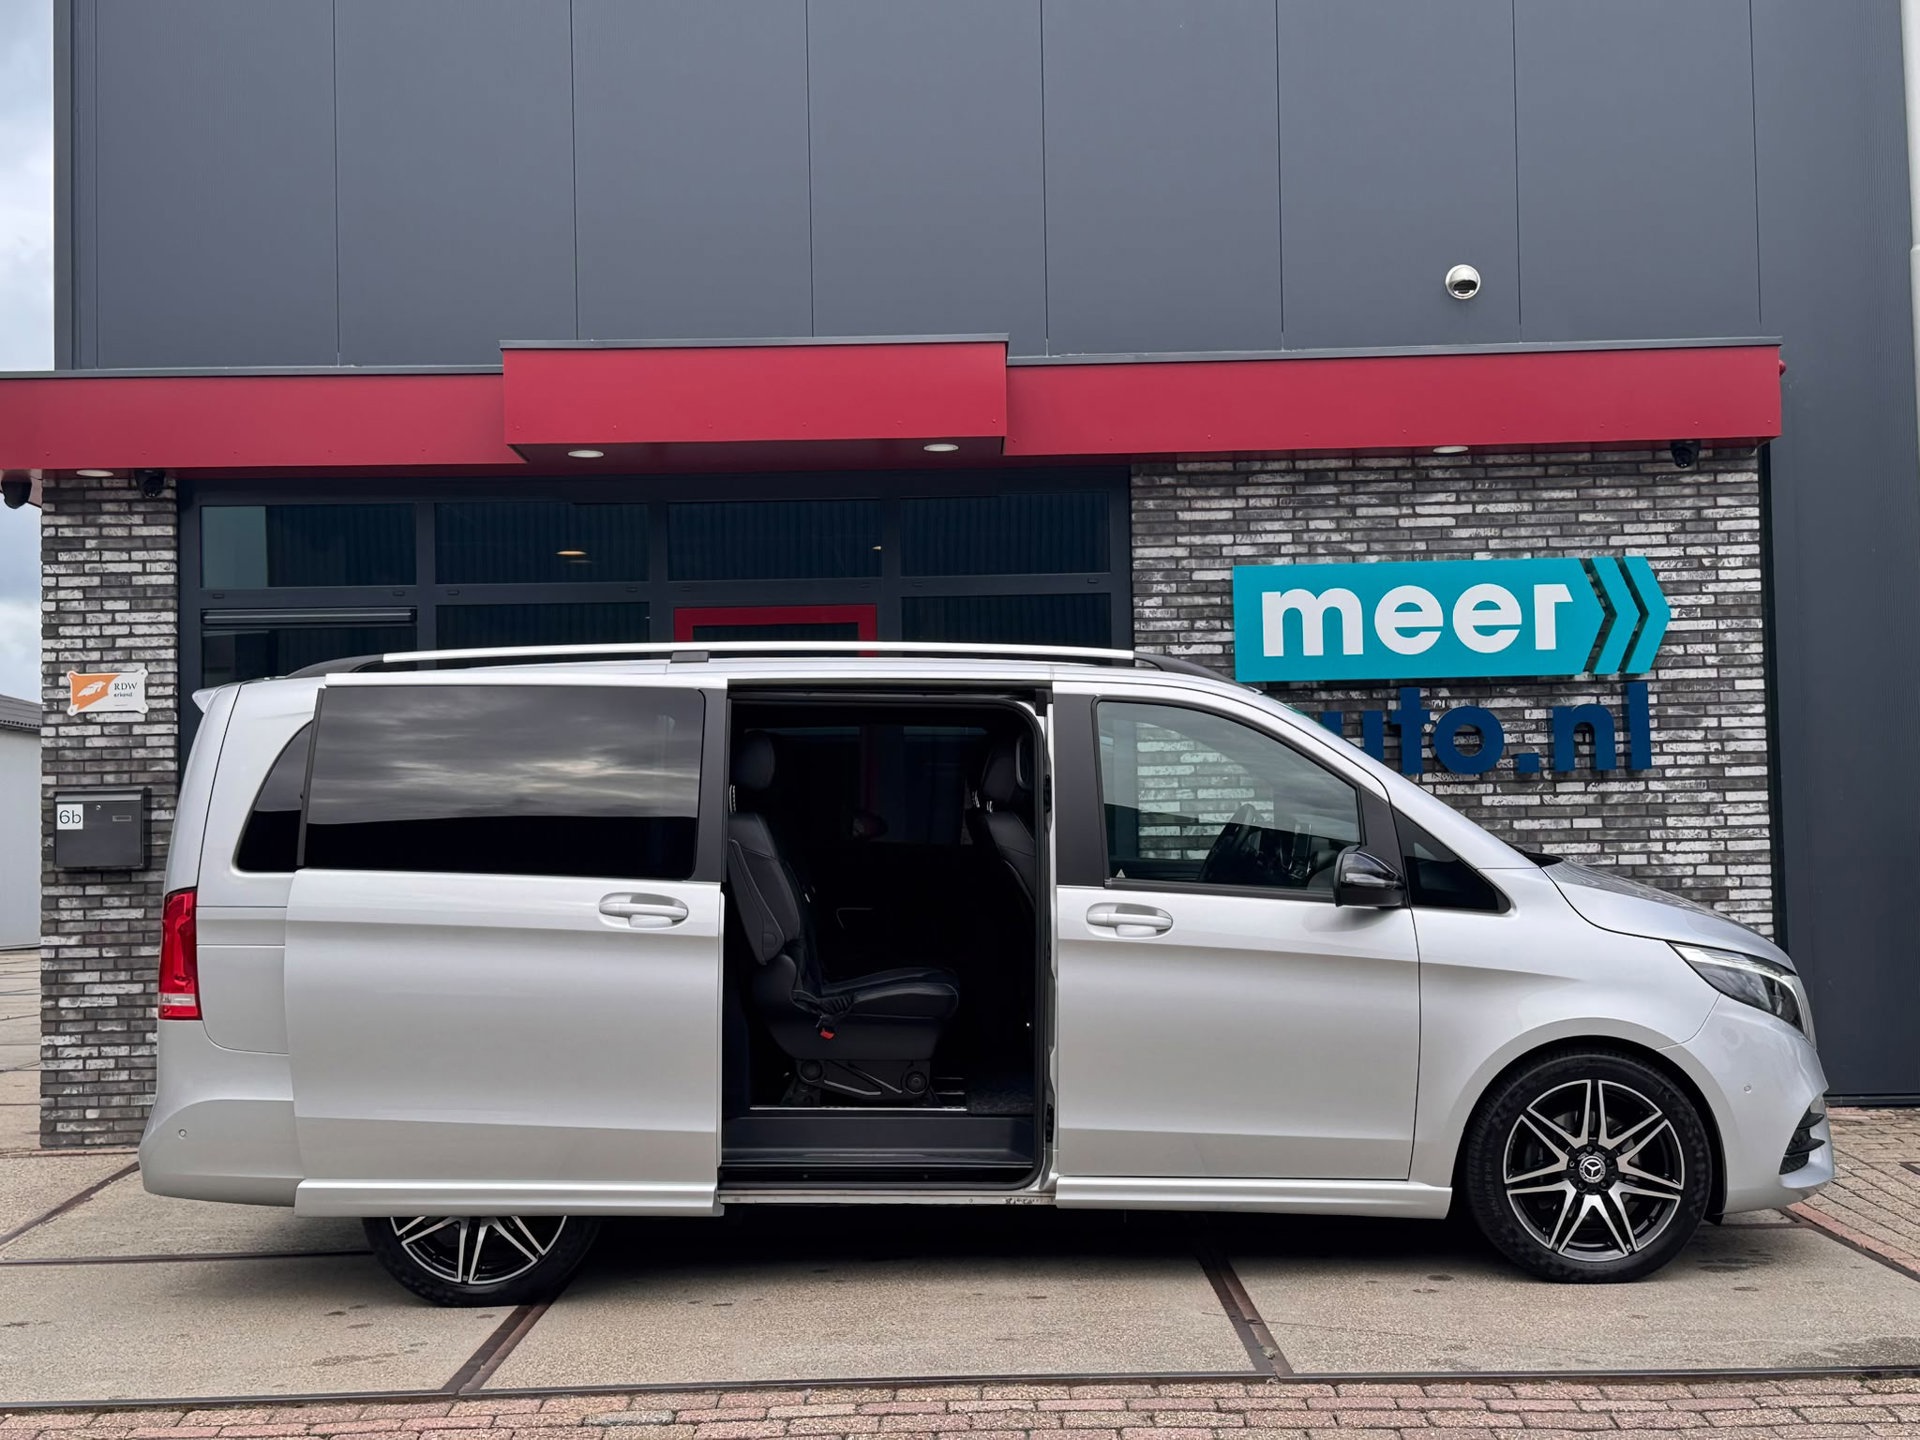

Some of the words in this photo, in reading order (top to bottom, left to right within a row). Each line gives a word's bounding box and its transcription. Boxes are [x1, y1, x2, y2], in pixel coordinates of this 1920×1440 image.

[1261, 583, 1574, 657] meer
[113, 682, 138, 690] RDW
[59, 809, 81, 824] 6b
